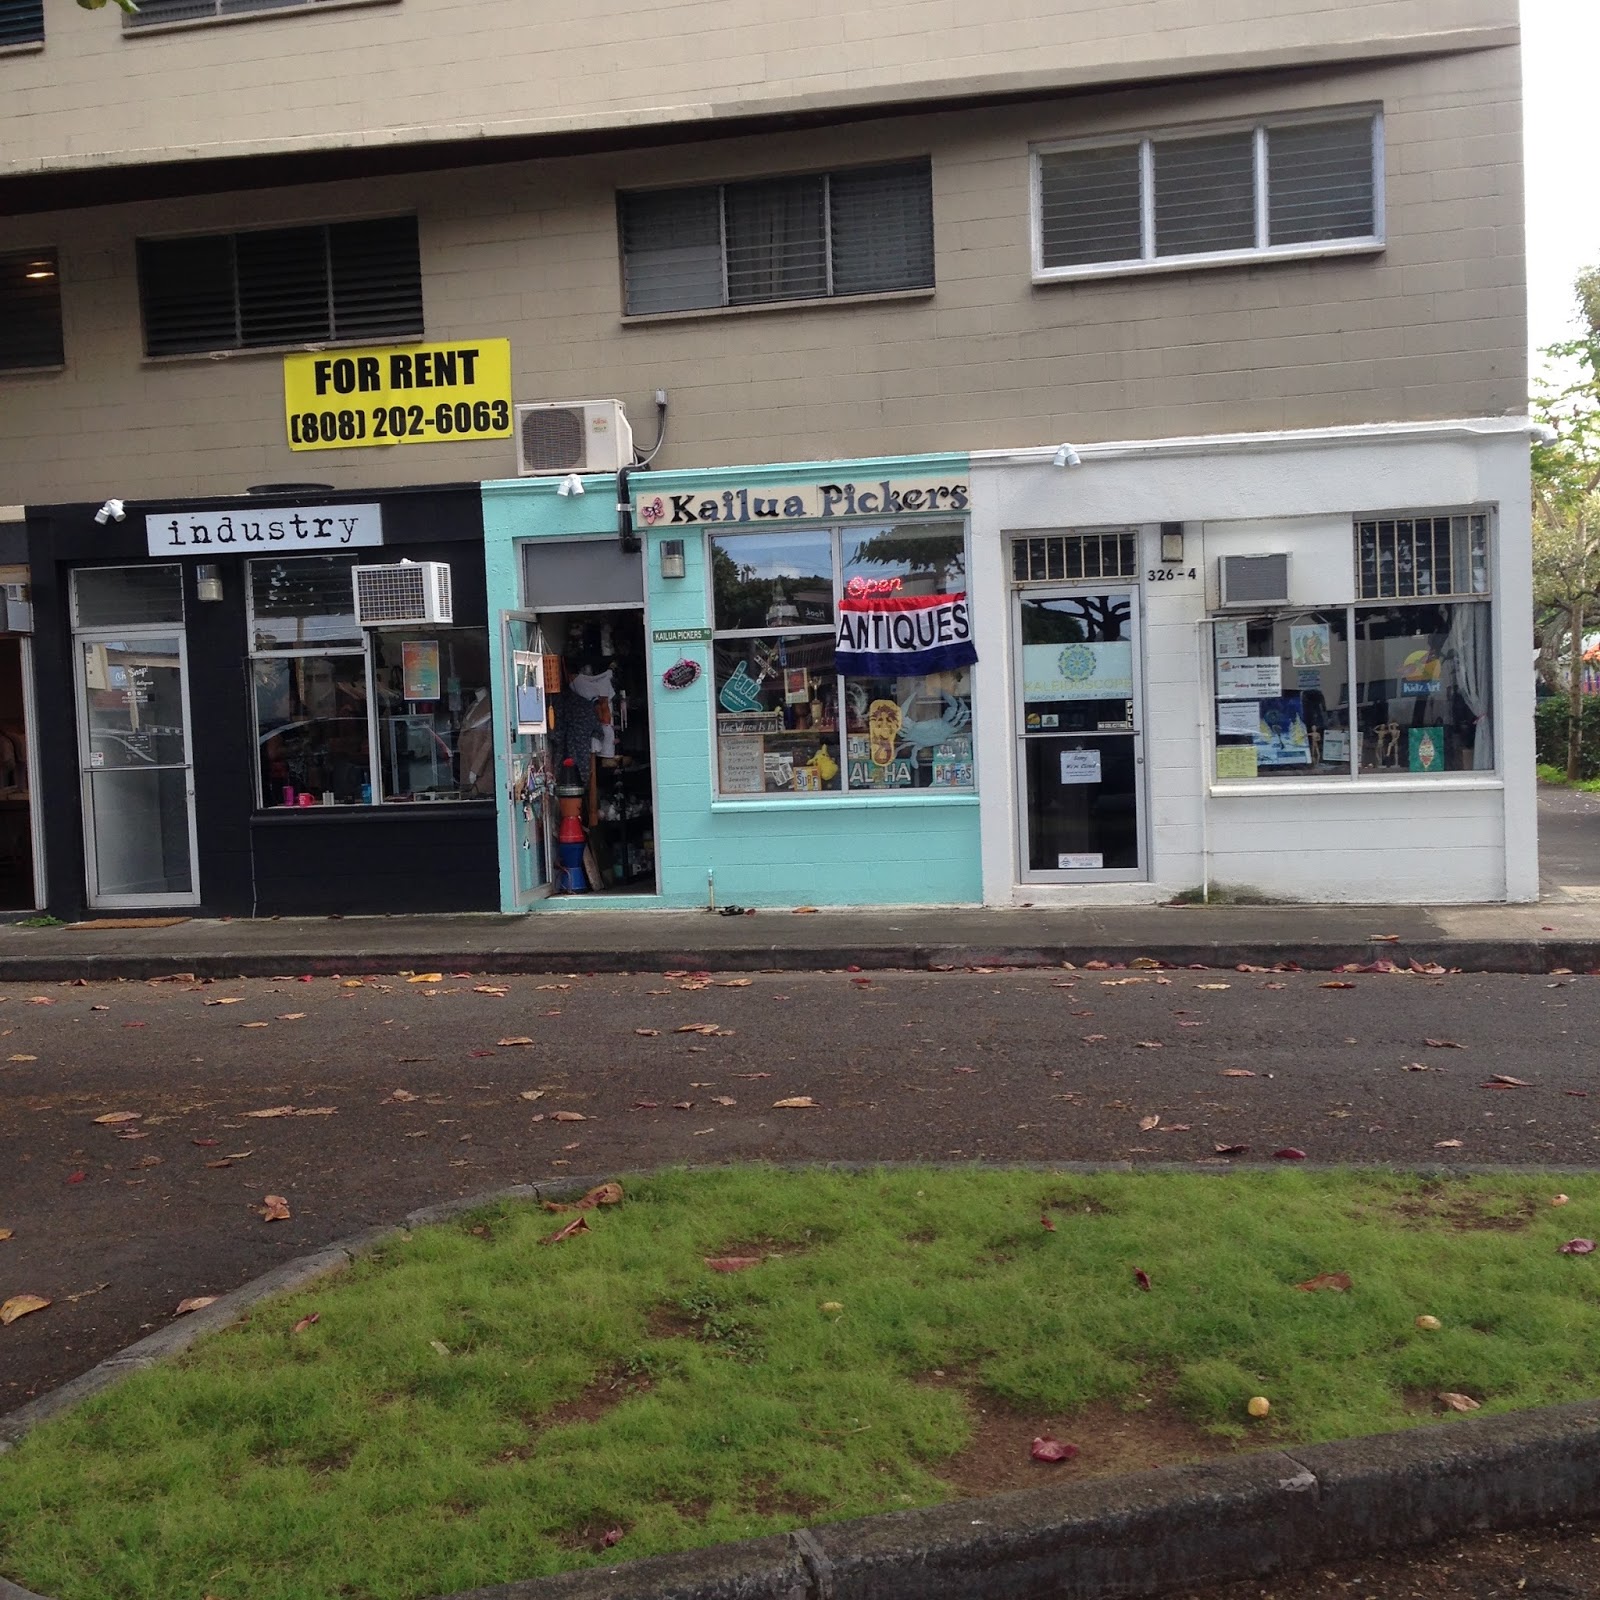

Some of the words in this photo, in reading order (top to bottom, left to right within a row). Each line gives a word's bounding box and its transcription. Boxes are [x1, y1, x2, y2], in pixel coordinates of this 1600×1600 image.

[315, 358, 381, 396] FOR
[390, 349, 479, 390] RENT
[291, 410, 366, 443] (808)
[372, 400, 510, 438] 202-6063
[670, 488, 807, 523] Kailua
[818, 480, 969, 517] Pickers
[168, 514, 359, 544] industry
[848, 575, 903, 600] Open
[1148, 568, 1196, 581] 326-4
[655, 632, 677, 641] KAILUA
[678, 630, 702, 640] PICKERS
[836, 603, 969, 651] ANTIQUES
